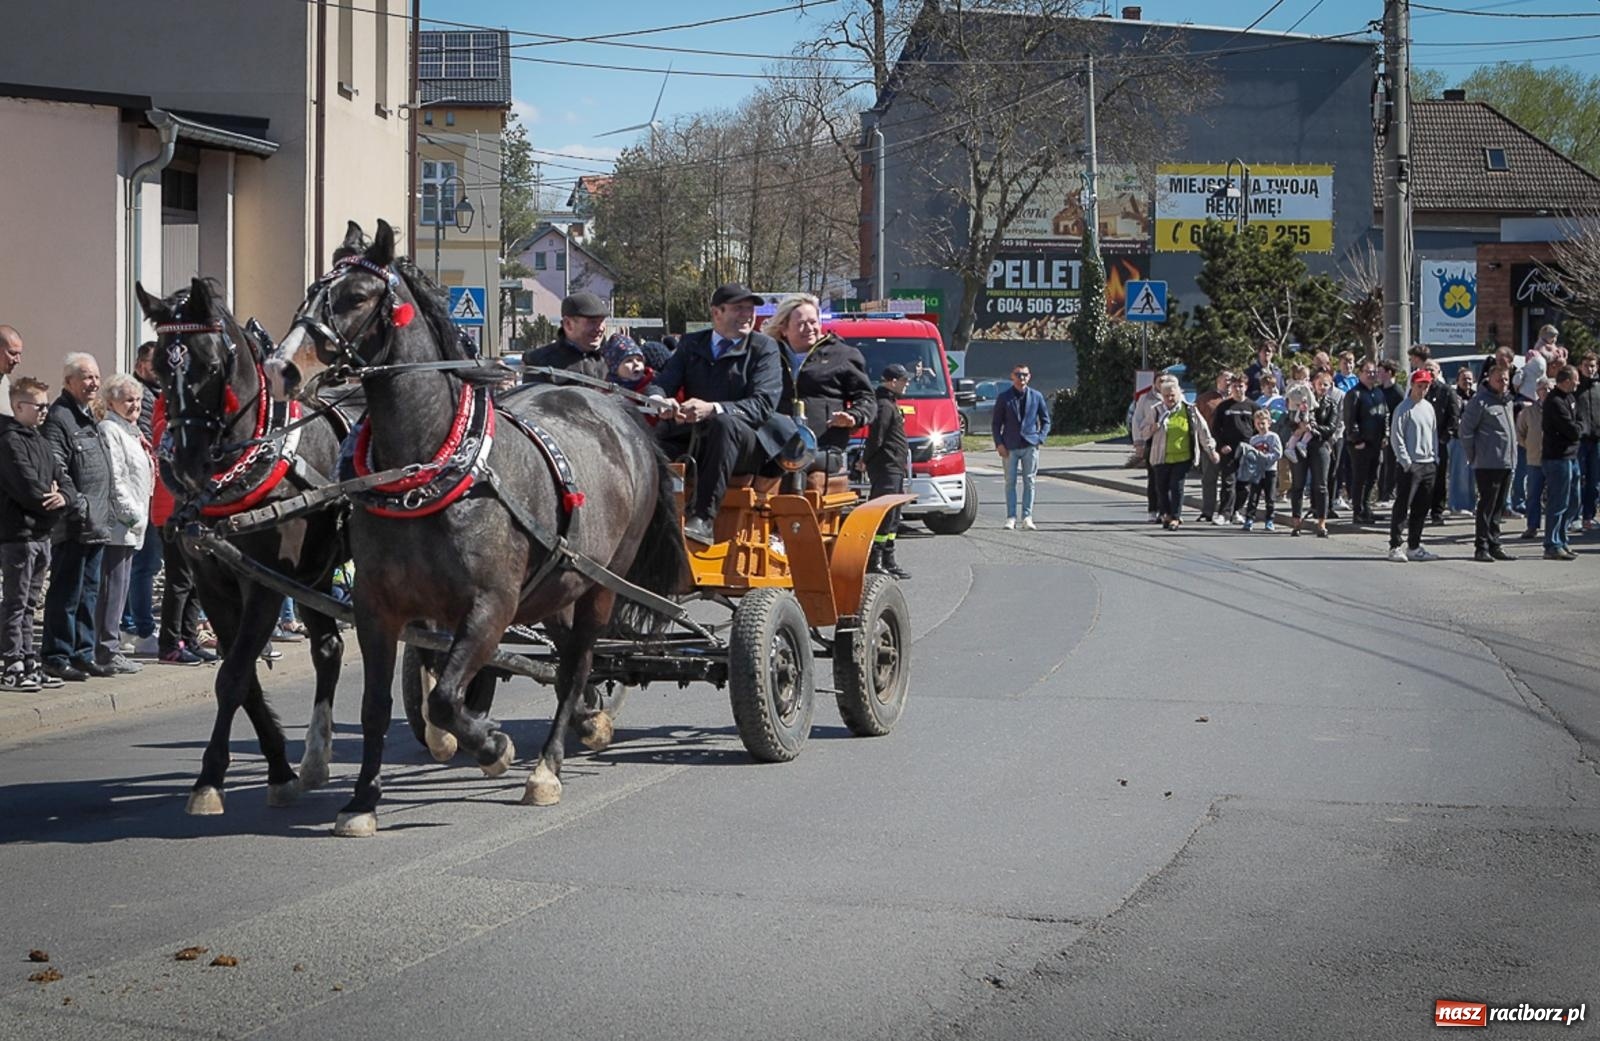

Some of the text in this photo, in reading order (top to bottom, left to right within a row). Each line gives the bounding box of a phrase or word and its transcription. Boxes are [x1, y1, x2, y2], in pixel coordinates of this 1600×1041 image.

[1266, 179, 1319, 198] TWOJĄ
[986, 259, 1082, 289] PELLET
[997, 298, 1023, 313] 604
[1027, 298, 1053, 313] 506
